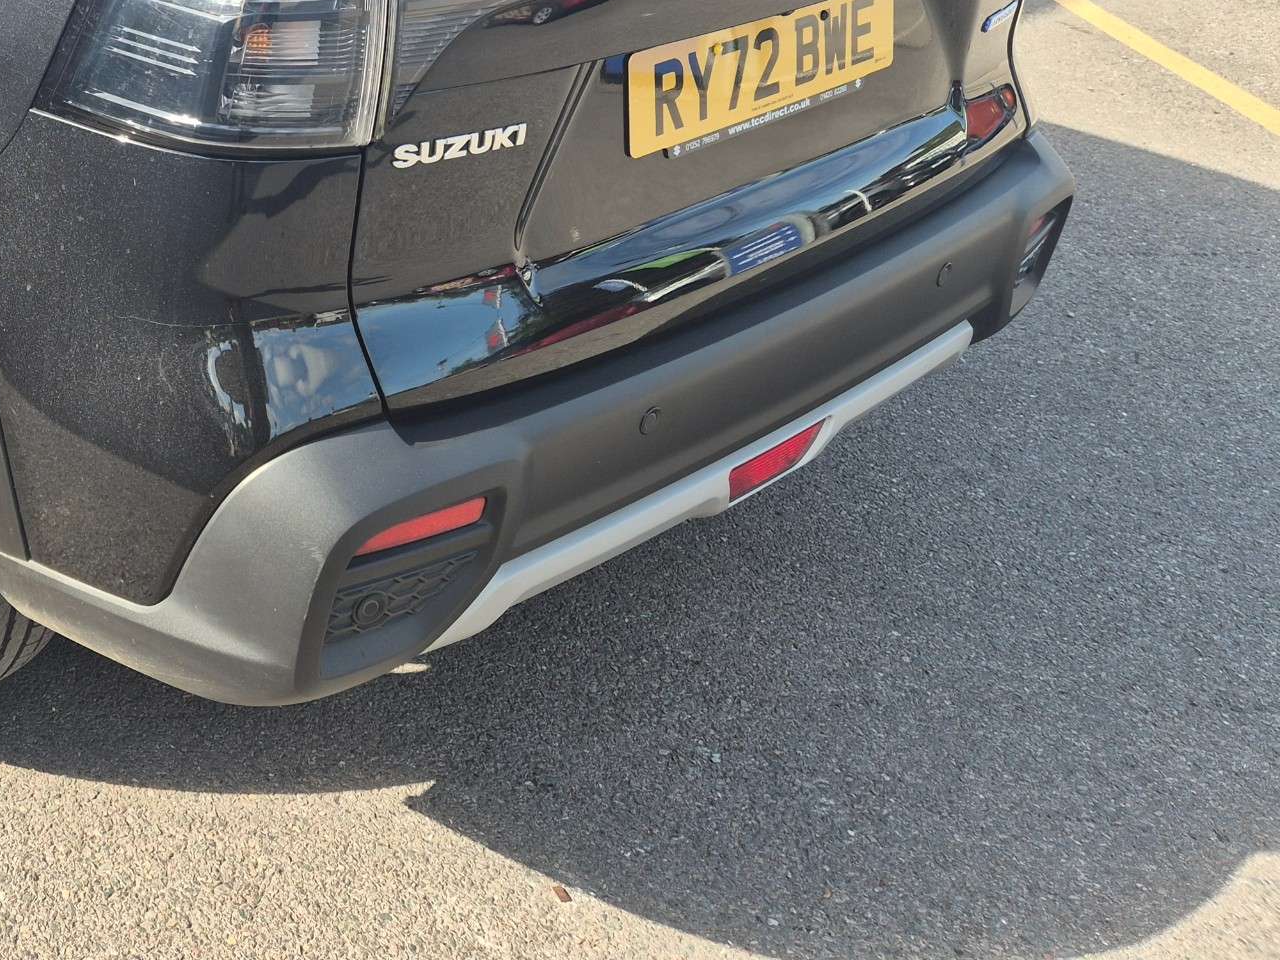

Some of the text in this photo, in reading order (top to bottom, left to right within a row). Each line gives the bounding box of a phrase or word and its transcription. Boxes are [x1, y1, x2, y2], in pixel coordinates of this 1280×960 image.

[653, 27, 781, 137] RY72
[728, 98, 811, 135] www.tccdirect.co.uk
[392, 123, 527, 169] SUZUKI
